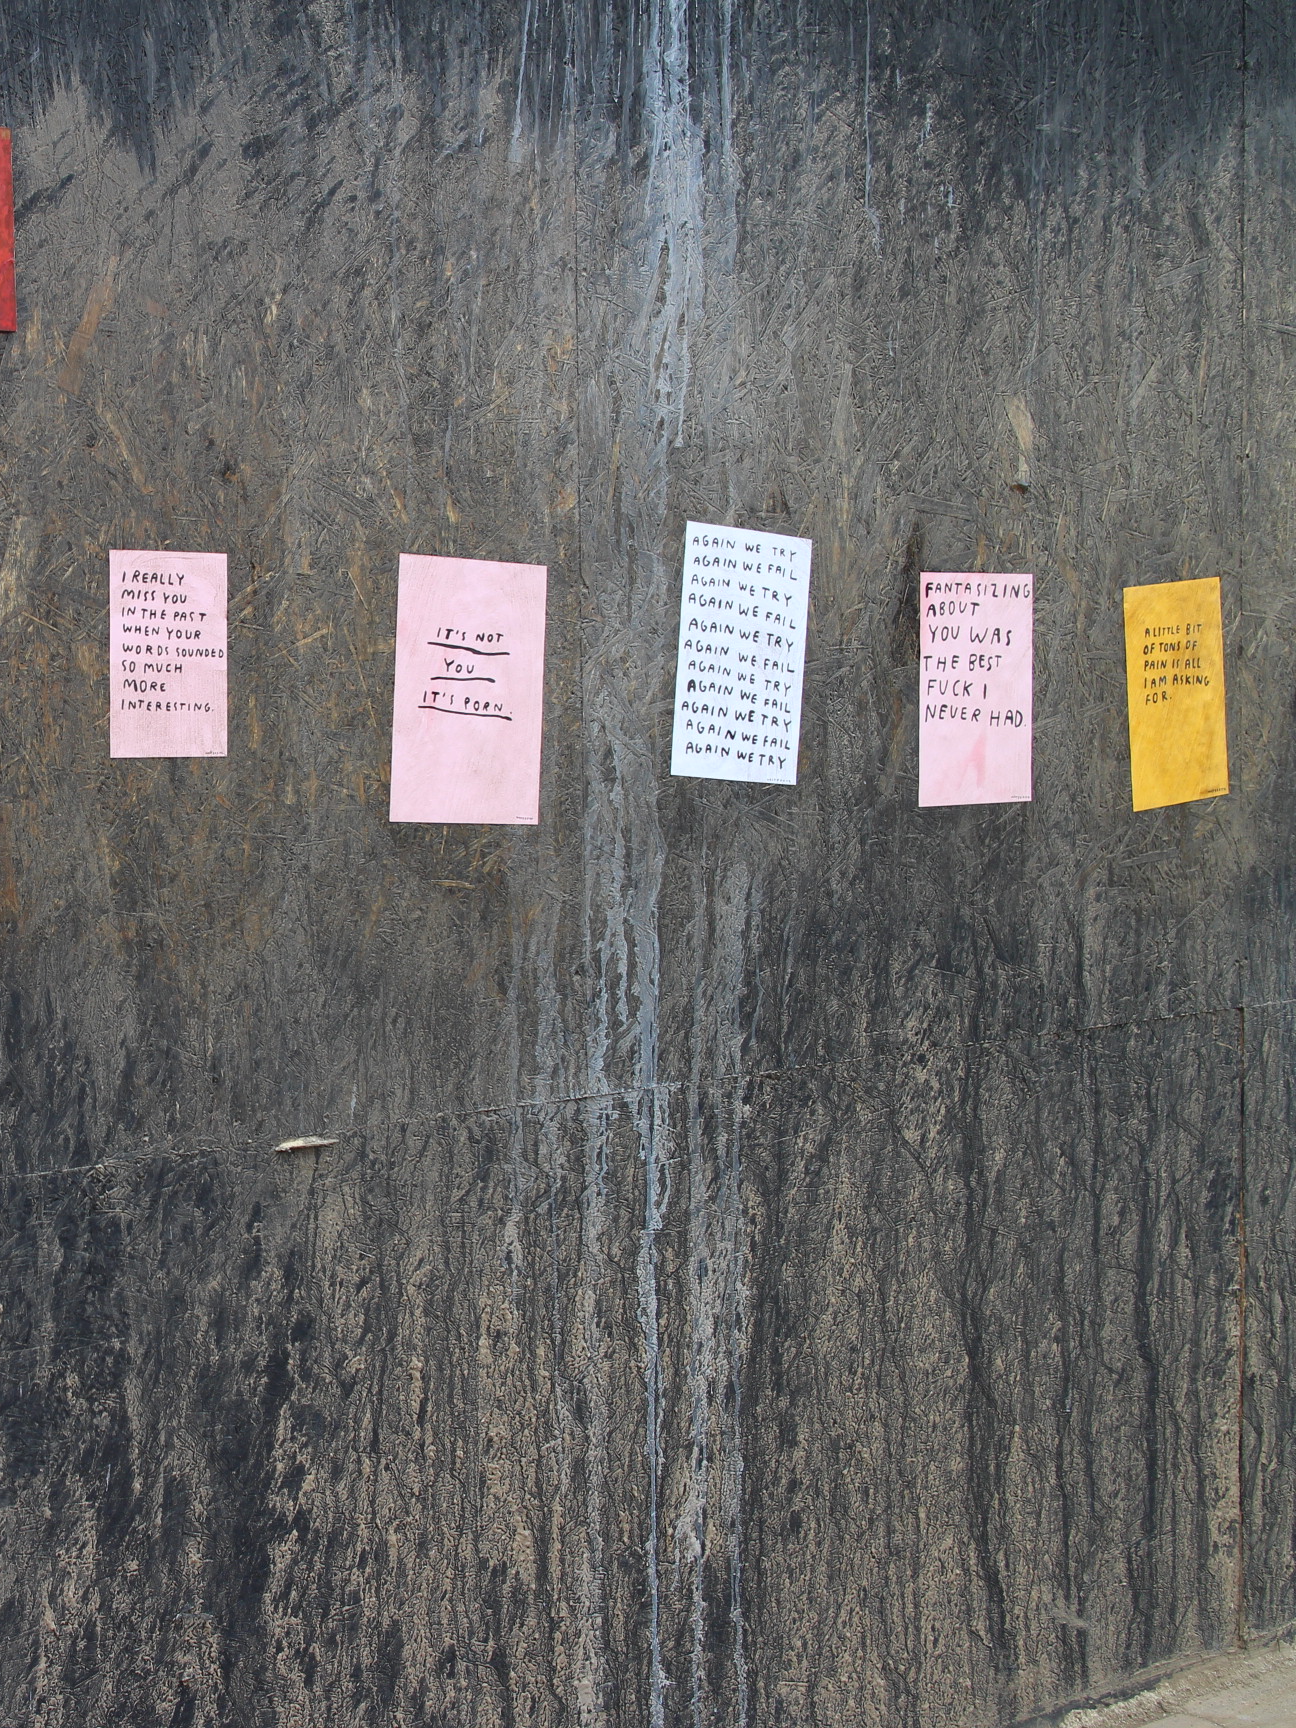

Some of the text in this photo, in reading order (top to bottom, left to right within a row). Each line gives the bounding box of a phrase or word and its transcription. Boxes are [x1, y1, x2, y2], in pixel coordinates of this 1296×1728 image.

[693, 535, 797, 562] AGAIN WE TRY
[694, 555, 797, 580] AGAIN WE FAIL
[122, 570, 185, 586] I REALLY
[121, 589, 187, 604] MISS YOU
[691, 574, 792, 607] AGAIN WE TRY
[925, 582, 1030, 598] FANTASIZING
[122, 607, 206, 622] IN THE PAST
[688, 593, 796, 629] AGAIN WE FAIL
[926, 601, 980, 617] ABOUT
[122, 624, 201, 640] WHEN YOUR
[437, 627, 504, 643] IT'S NOT
[688, 618, 794, 653] AGAIN WE TRY
[929, 624, 1012, 646] YOU WAS
[1186, 624, 1202, 635] BIT
[122, 643, 224, 658] WORDS SOUNDED
[684, 639, 795, 672] AGAIN WE FAIL
[1143, 641, 1197, 655] OF TONS OF
[122, 660, 183, 674] SO MUCH
[444, 658, 475, 674] YOU
[924, 654, 1002, 672] THE BEST
[1144, 658, 1201, 671] PAIN IS ALL
[123, 679, 166, 692] MORE
[688, 660, 791, 697] AGAIN WE TRY
[1144, 674, 1210, 689] I AM ASKING
[687, 679, 791, 713] AGAIN WE FAIL
[927, 679, 987, 699] FUCK I
[423, 690, 454, 705] IT'S
[1145, 691, 1172, 705] FOR.
[121, 699, 214, 713] INTERESTING.
[925, 704, 981, 722] NEVER
[681, 701, 792, 733] AGAIN WE TRY
[686, 719, 790, 750] AGAIN WE FAIL
[686, 742, 786, 769] AGAIN WE TRY
